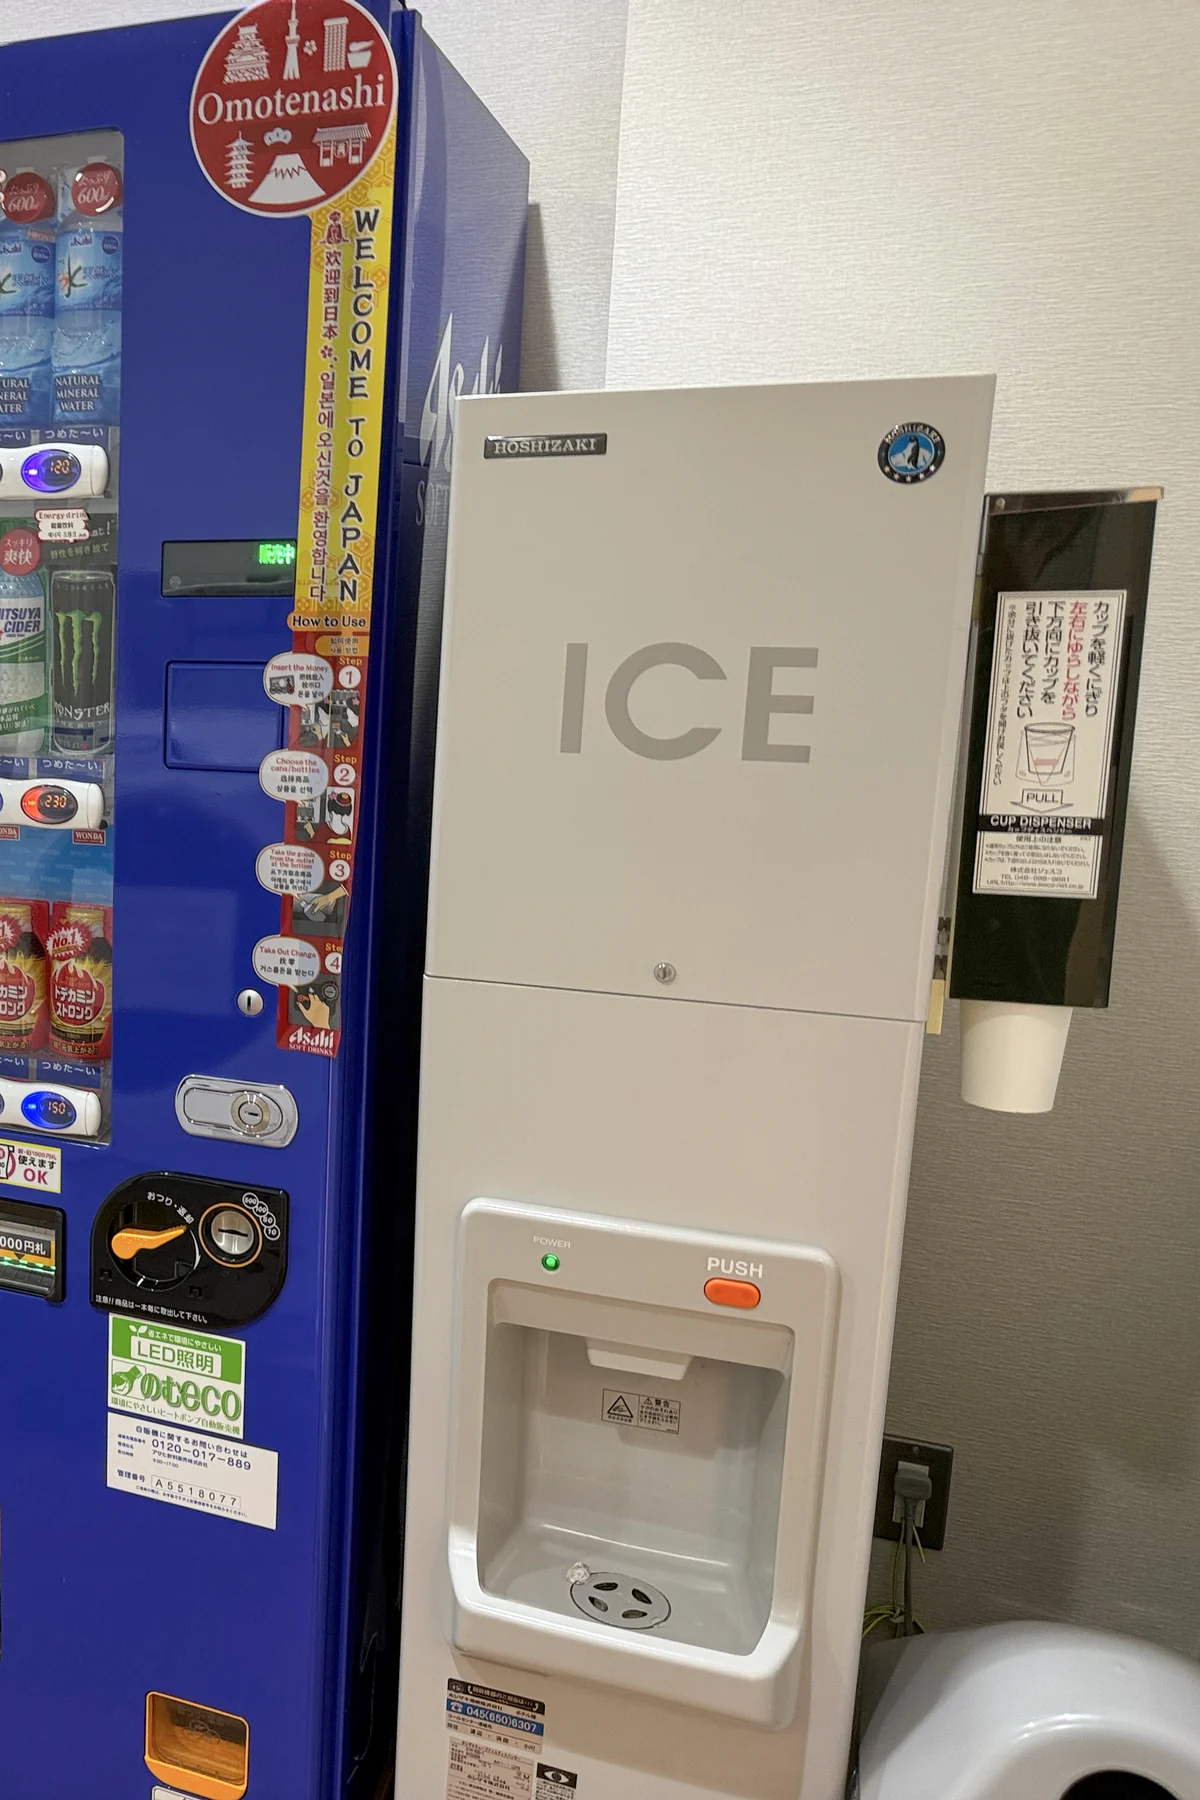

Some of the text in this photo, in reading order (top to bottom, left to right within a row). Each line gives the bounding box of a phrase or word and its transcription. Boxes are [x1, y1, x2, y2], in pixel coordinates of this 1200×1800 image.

[197, 73, 385, 125] Omotenashi
[321, 250, 342, 341] 欢迎到日本
[55, 375, 101, 387] NATURAL
[56, 387, 100, 399] MINERAL
[60, 400, 94, 411] WATER
[337, 208, 380, 602] WELCOME TO JAPAN
[494, 438, 597, 454] HOSHIZAKI
[50, 460, 70, 473] 120
[39, 511, 66, 520] Energy
[5, 539, 33, 548] スッキリ
[3, 548, 33, 566] 爽快
[4, 620, 41, 633] CIDER
[292, 615, 366, 627] How to Use
[339, 656, 362, 666] Step
[306, 664, 329, 672] Money
[345, 671, 353, 684] 1
[559, 641, 819, 764] ICE
[54, 701, 111, 721] MONSTER
[334, 754, 357, 764] Step
[271, 764, 320, 774] cans/bottles
[340, 768, 350, 781] 2
[45, 795, 67, 808] 230
[1026, 793, 1059, 804] PULL
[990, 815, 1092, 830] CUP DISPENSER
[75, 831, 103, 841] WONDA
[270, 848, 285, 856] Take
[329, 850, 352, 860] Step
[334, 864, 345, 877] 3
[52, 931, 78, 948] No.1
[260, 946, 317, 959] Take Out Change
[325, 943, 343, 952] Ste
[330, 957, 341, 970] 4
[54, 986, 96, 1005] ドデカミン
[56, 1004, 94, 1020] ストロング
[288, 1026, 334, 1049] Asahi
[288, 1043, 333, 1056] SOFT DRINKS
[17, 1155, 57, 1170] 使えます
[23, 1168, 49, 1185] OK
[533, 1235, 572, 1248] POWER
[707, 1257, 764, 1279] PUSH
[147, 1329, 222, 1352] 省エネで環境にやさしい
[137, 1340, 214, 1374] LED照明
